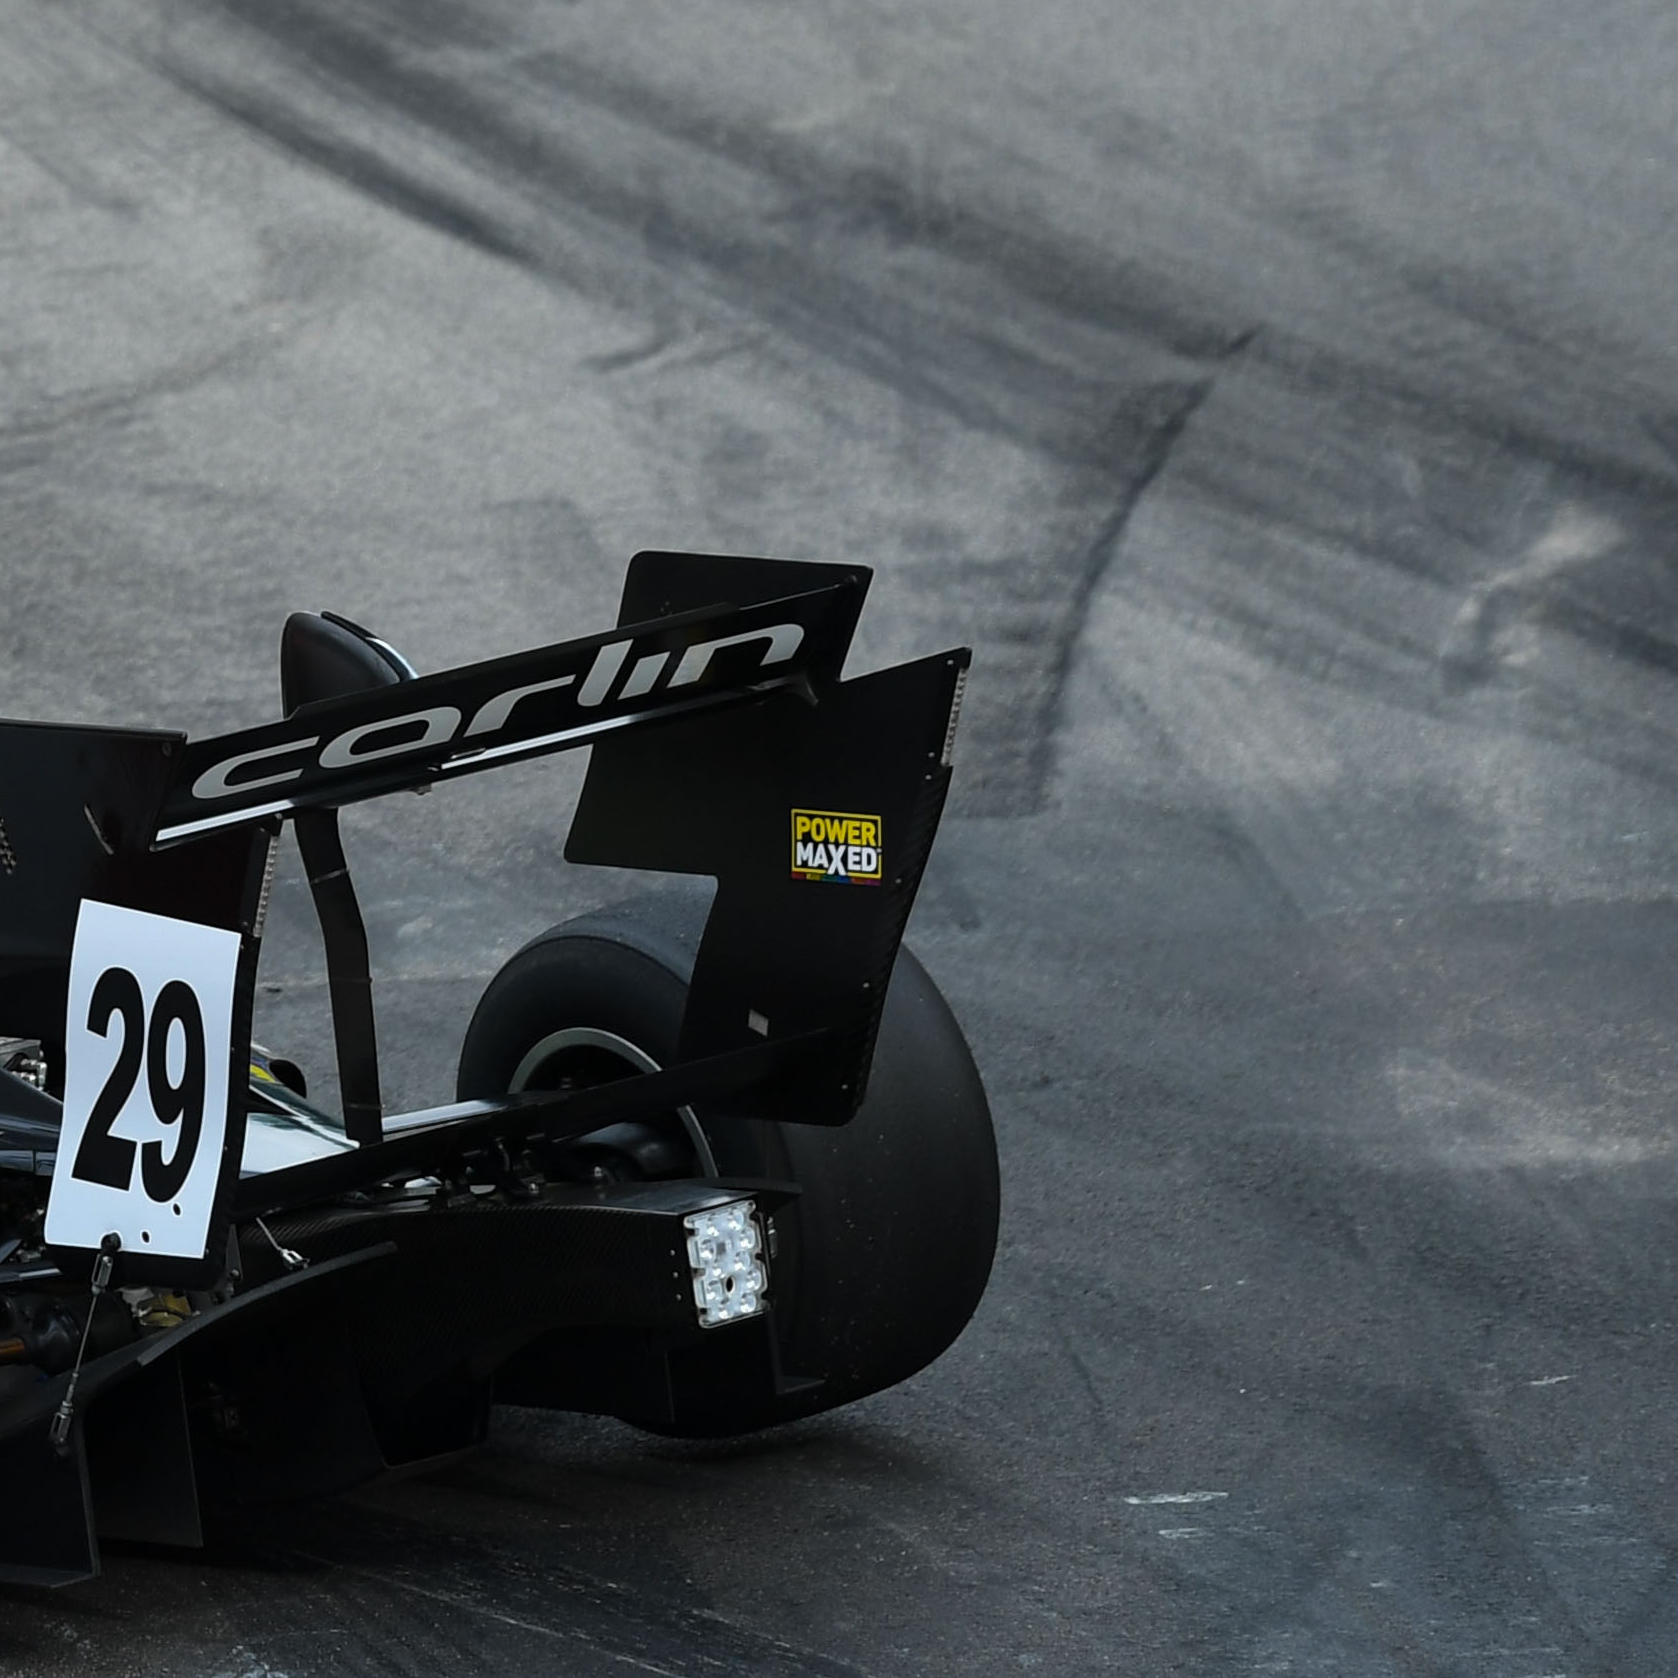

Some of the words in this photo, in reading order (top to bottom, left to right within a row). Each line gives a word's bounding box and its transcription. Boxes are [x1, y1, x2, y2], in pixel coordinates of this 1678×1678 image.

[191, 622, 805, 800] carlin
[796, 815, 877, 847] POWER
[796, 841, 878, 876] MAXED
[71, 966, 206, 1203] 29
